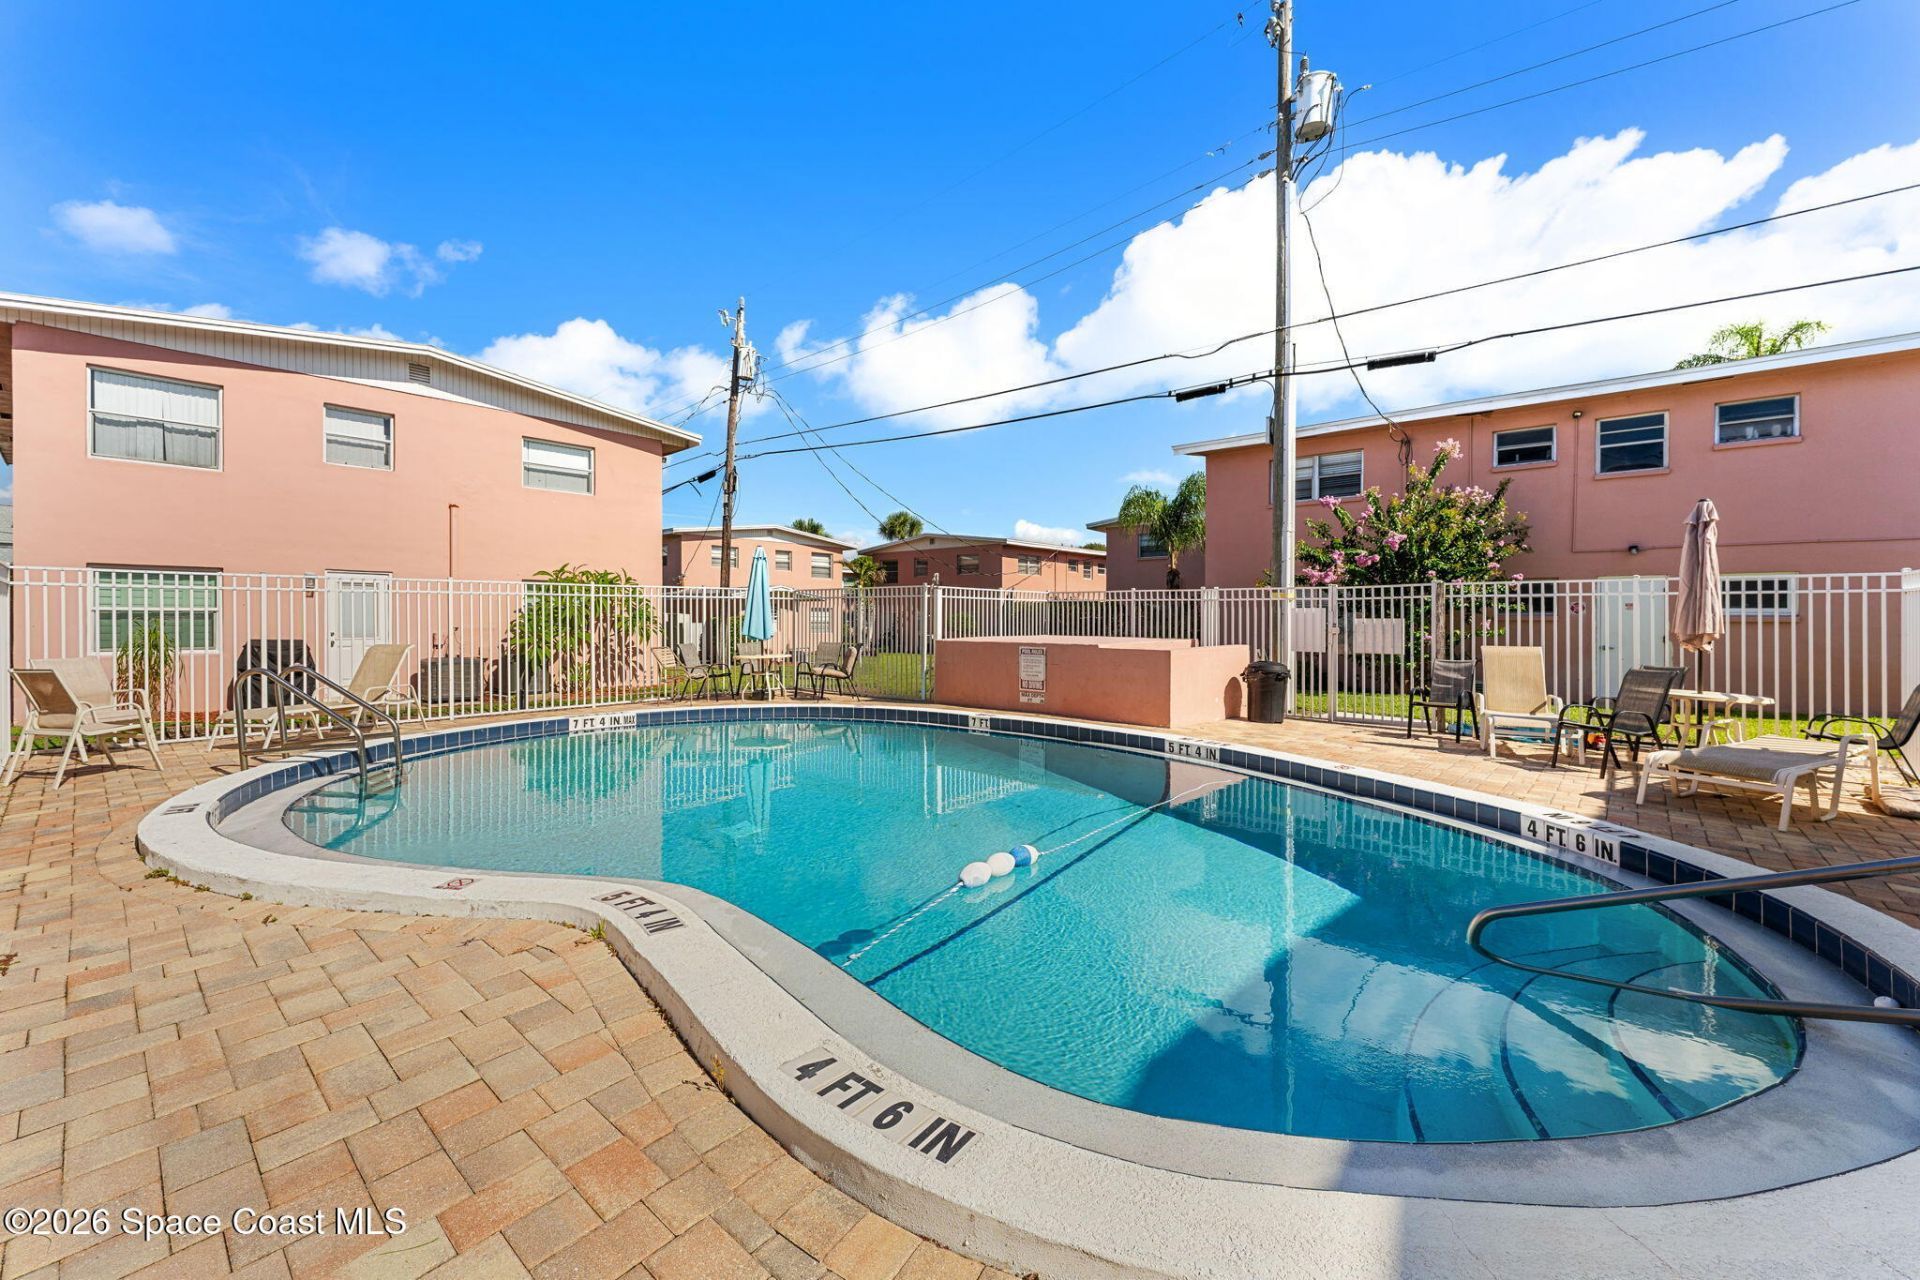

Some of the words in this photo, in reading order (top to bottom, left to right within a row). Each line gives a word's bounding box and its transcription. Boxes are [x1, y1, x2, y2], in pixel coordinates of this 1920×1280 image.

[573, 719, 579, 729] 7
[599, 717, 606, 727] 4
[971, 717, 976, 727] 7
[1168, 742, 1175, 753] 5
[1195, 745, 1202, 758] 4
[1527, 820, 1538, 837] 4
[1575, 833, 1586, 852] 6
[1595, 838, 1618, 863] IN.
[613, 896, 657, 911] FT
[643, 917, 684, 934] IN
[794, 1057, 838, 1082] 4
[816, 1071, 860, 1110] FT
[872, 1101, 914, 1130] 6
[907, 1116, 977, 1164] IN
